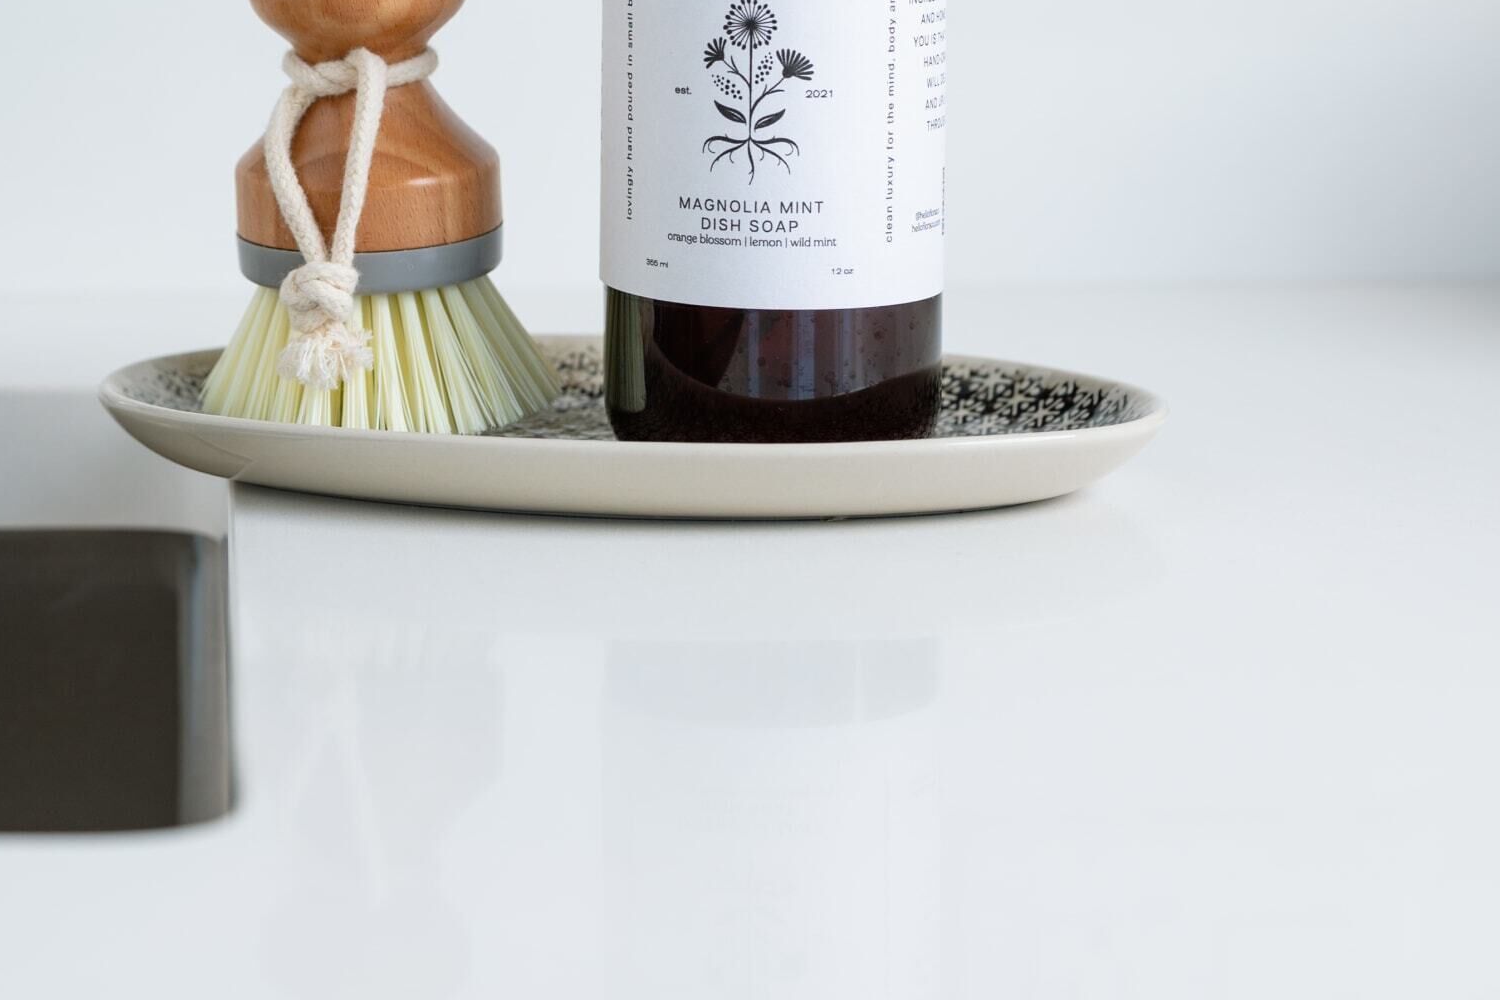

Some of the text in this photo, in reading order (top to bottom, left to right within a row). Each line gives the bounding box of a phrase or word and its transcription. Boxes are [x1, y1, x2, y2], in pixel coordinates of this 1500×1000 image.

[921, 11, 935, 24] AND
[888, 18, 897, 53] body
[914, 34, 929, 47] YOU
[626, 54, 633, 67] in
[674, 85, 692, 95] est.
[805, 89, 834, 99] 2021
[925, 96, 937, 110] AND
[887, 102, 895, 124] the
[886, 131, 894, 150] for
[885, 156, 895, 200] luxury
[626, 166, 634, 220] lovingly
[678, 196, 824, 214] MAGNOLIA MINT
[701, 217, 799, 233] DISH SOAP
[885, 205, 893, 243] clean
[667, 232, 698, 245] orange
[699, 233, 742, 247] blossom
[749, 236, 782, 248] lemon
[790, 237, 811, 248] wild
[813, 237, 837, 248] mint
[659, 260, 669, 269] ml
[831, 267, 855, 275] 12 oz
